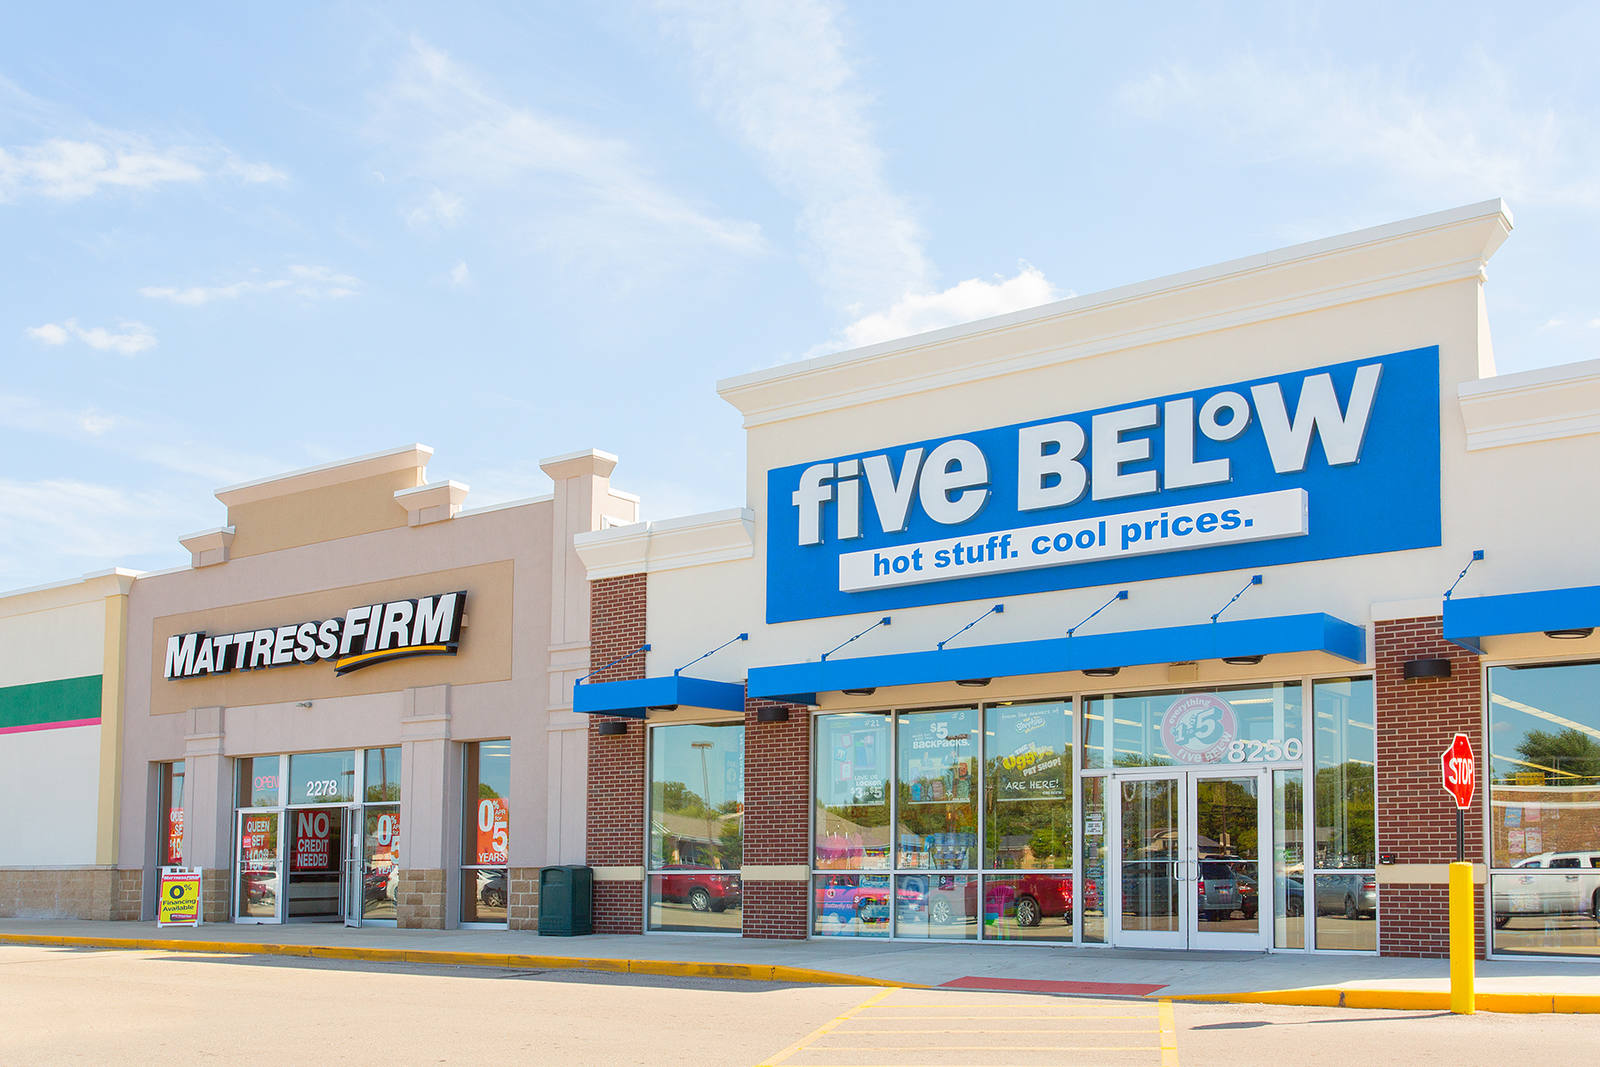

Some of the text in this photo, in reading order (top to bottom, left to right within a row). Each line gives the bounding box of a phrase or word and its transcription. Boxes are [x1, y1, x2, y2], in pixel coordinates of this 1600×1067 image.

[792, 363, 1382, 546] five BELOW
[873, 508, 1254, 577] hot stuff. cool prices.
[929, 722, 949, 739] $5
[1228, 737, 1303, 763] 8250
[1022, 757, 1062, 777] PET SHOP!
[1448, 757, 1473, 785] STOP
[305, 779, 338, 797] 2278
[1005, 778, 1059, 791] ARE HERE!
[246, 820, 270, 833] QUEEN
[297, 812, 330, 838] NO
[251, 834, 265, 847] SET
[491, 821, 508, 852] 5
[297, 838, 329, 853] CREDIT
[296, 853, 329, 867] NEEDED
[478, 852, 506, 863] YEARS
[162, 898, 197, 906] Financing
[162, 904, 195, 912] Available
